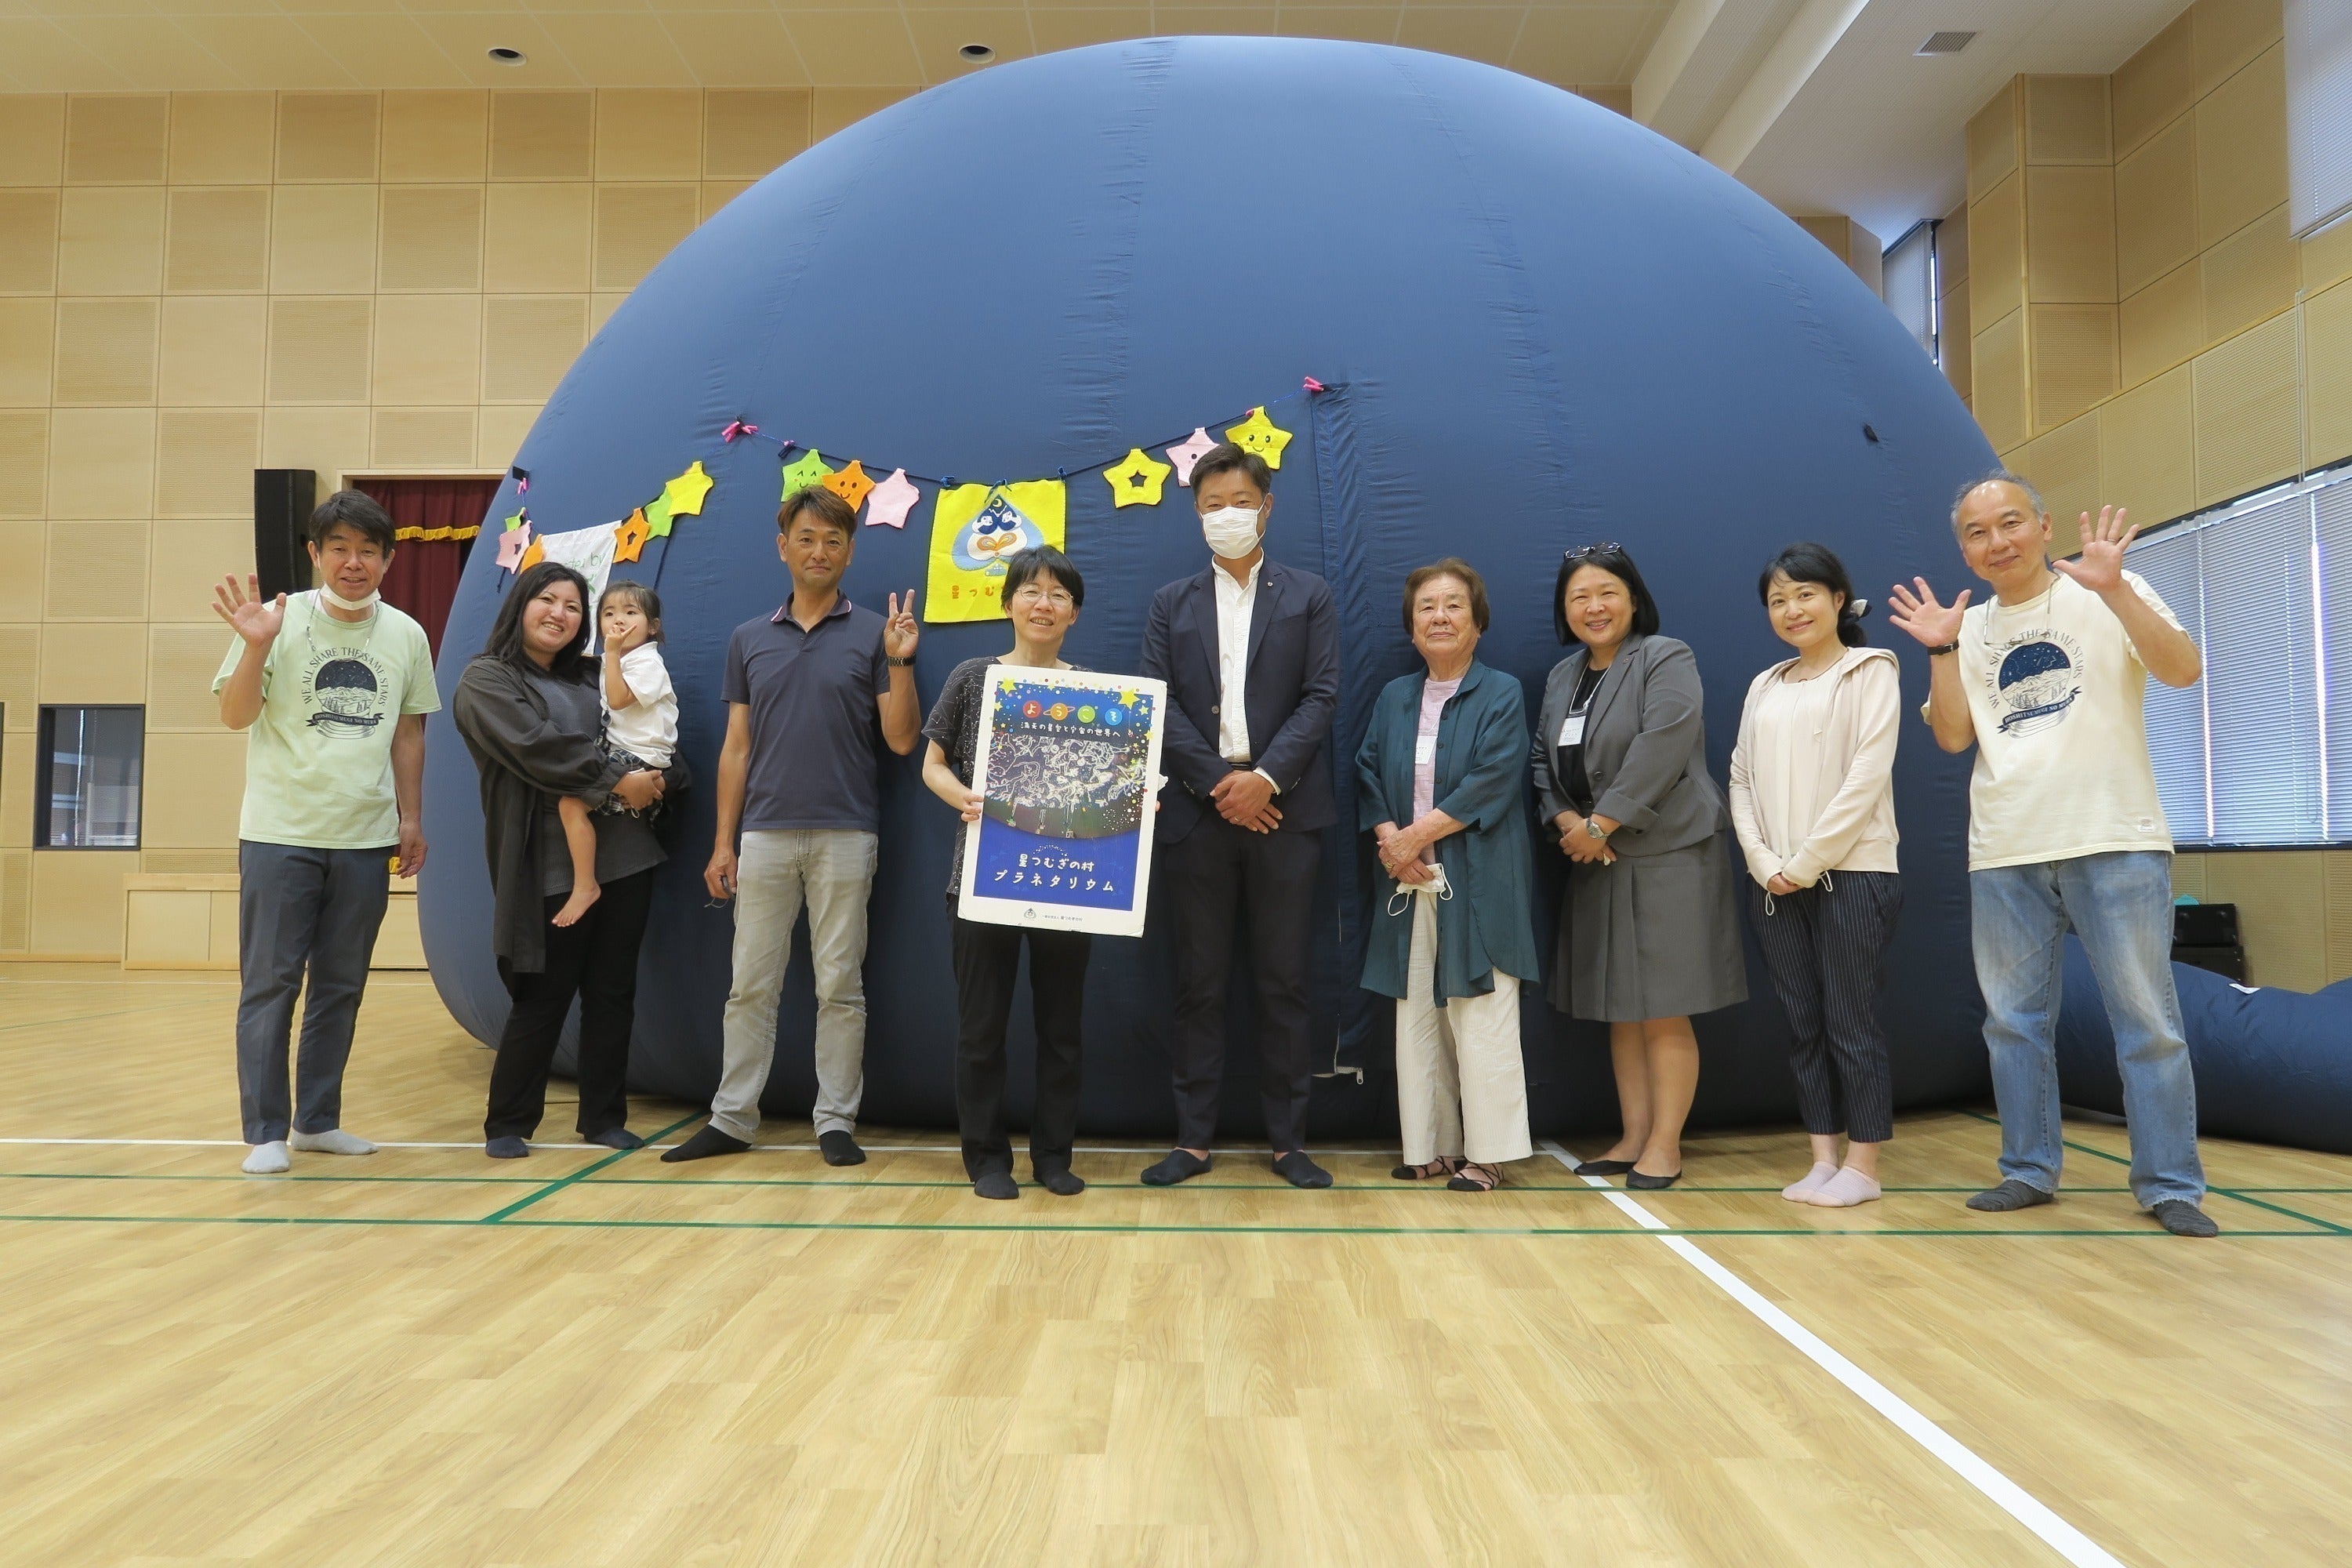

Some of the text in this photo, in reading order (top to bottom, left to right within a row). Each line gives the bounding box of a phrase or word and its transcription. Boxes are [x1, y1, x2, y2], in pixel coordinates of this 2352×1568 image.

[952, 586, 1004, 599] 星つむ
[2018, 628, 2042, 641] THE
[2046, 628, 2075, 649] SAME
[2072, 646, 2085, 679] STARS
[301, 647, 389, 706] WE ALL SHARE THE SAME STARS
[1985, 670, 1996, 688] ALL
[1989, 691, 2000, 709] WE
[1026, 703, 1119, 722] ようこそ
[1020, 721, 1121, 738] 満天の星空と宇宙の世界へ
[1018, 853, 1094, 873] 星つむぎの村
[994, 869, 1114, 892] プラネタリウム
